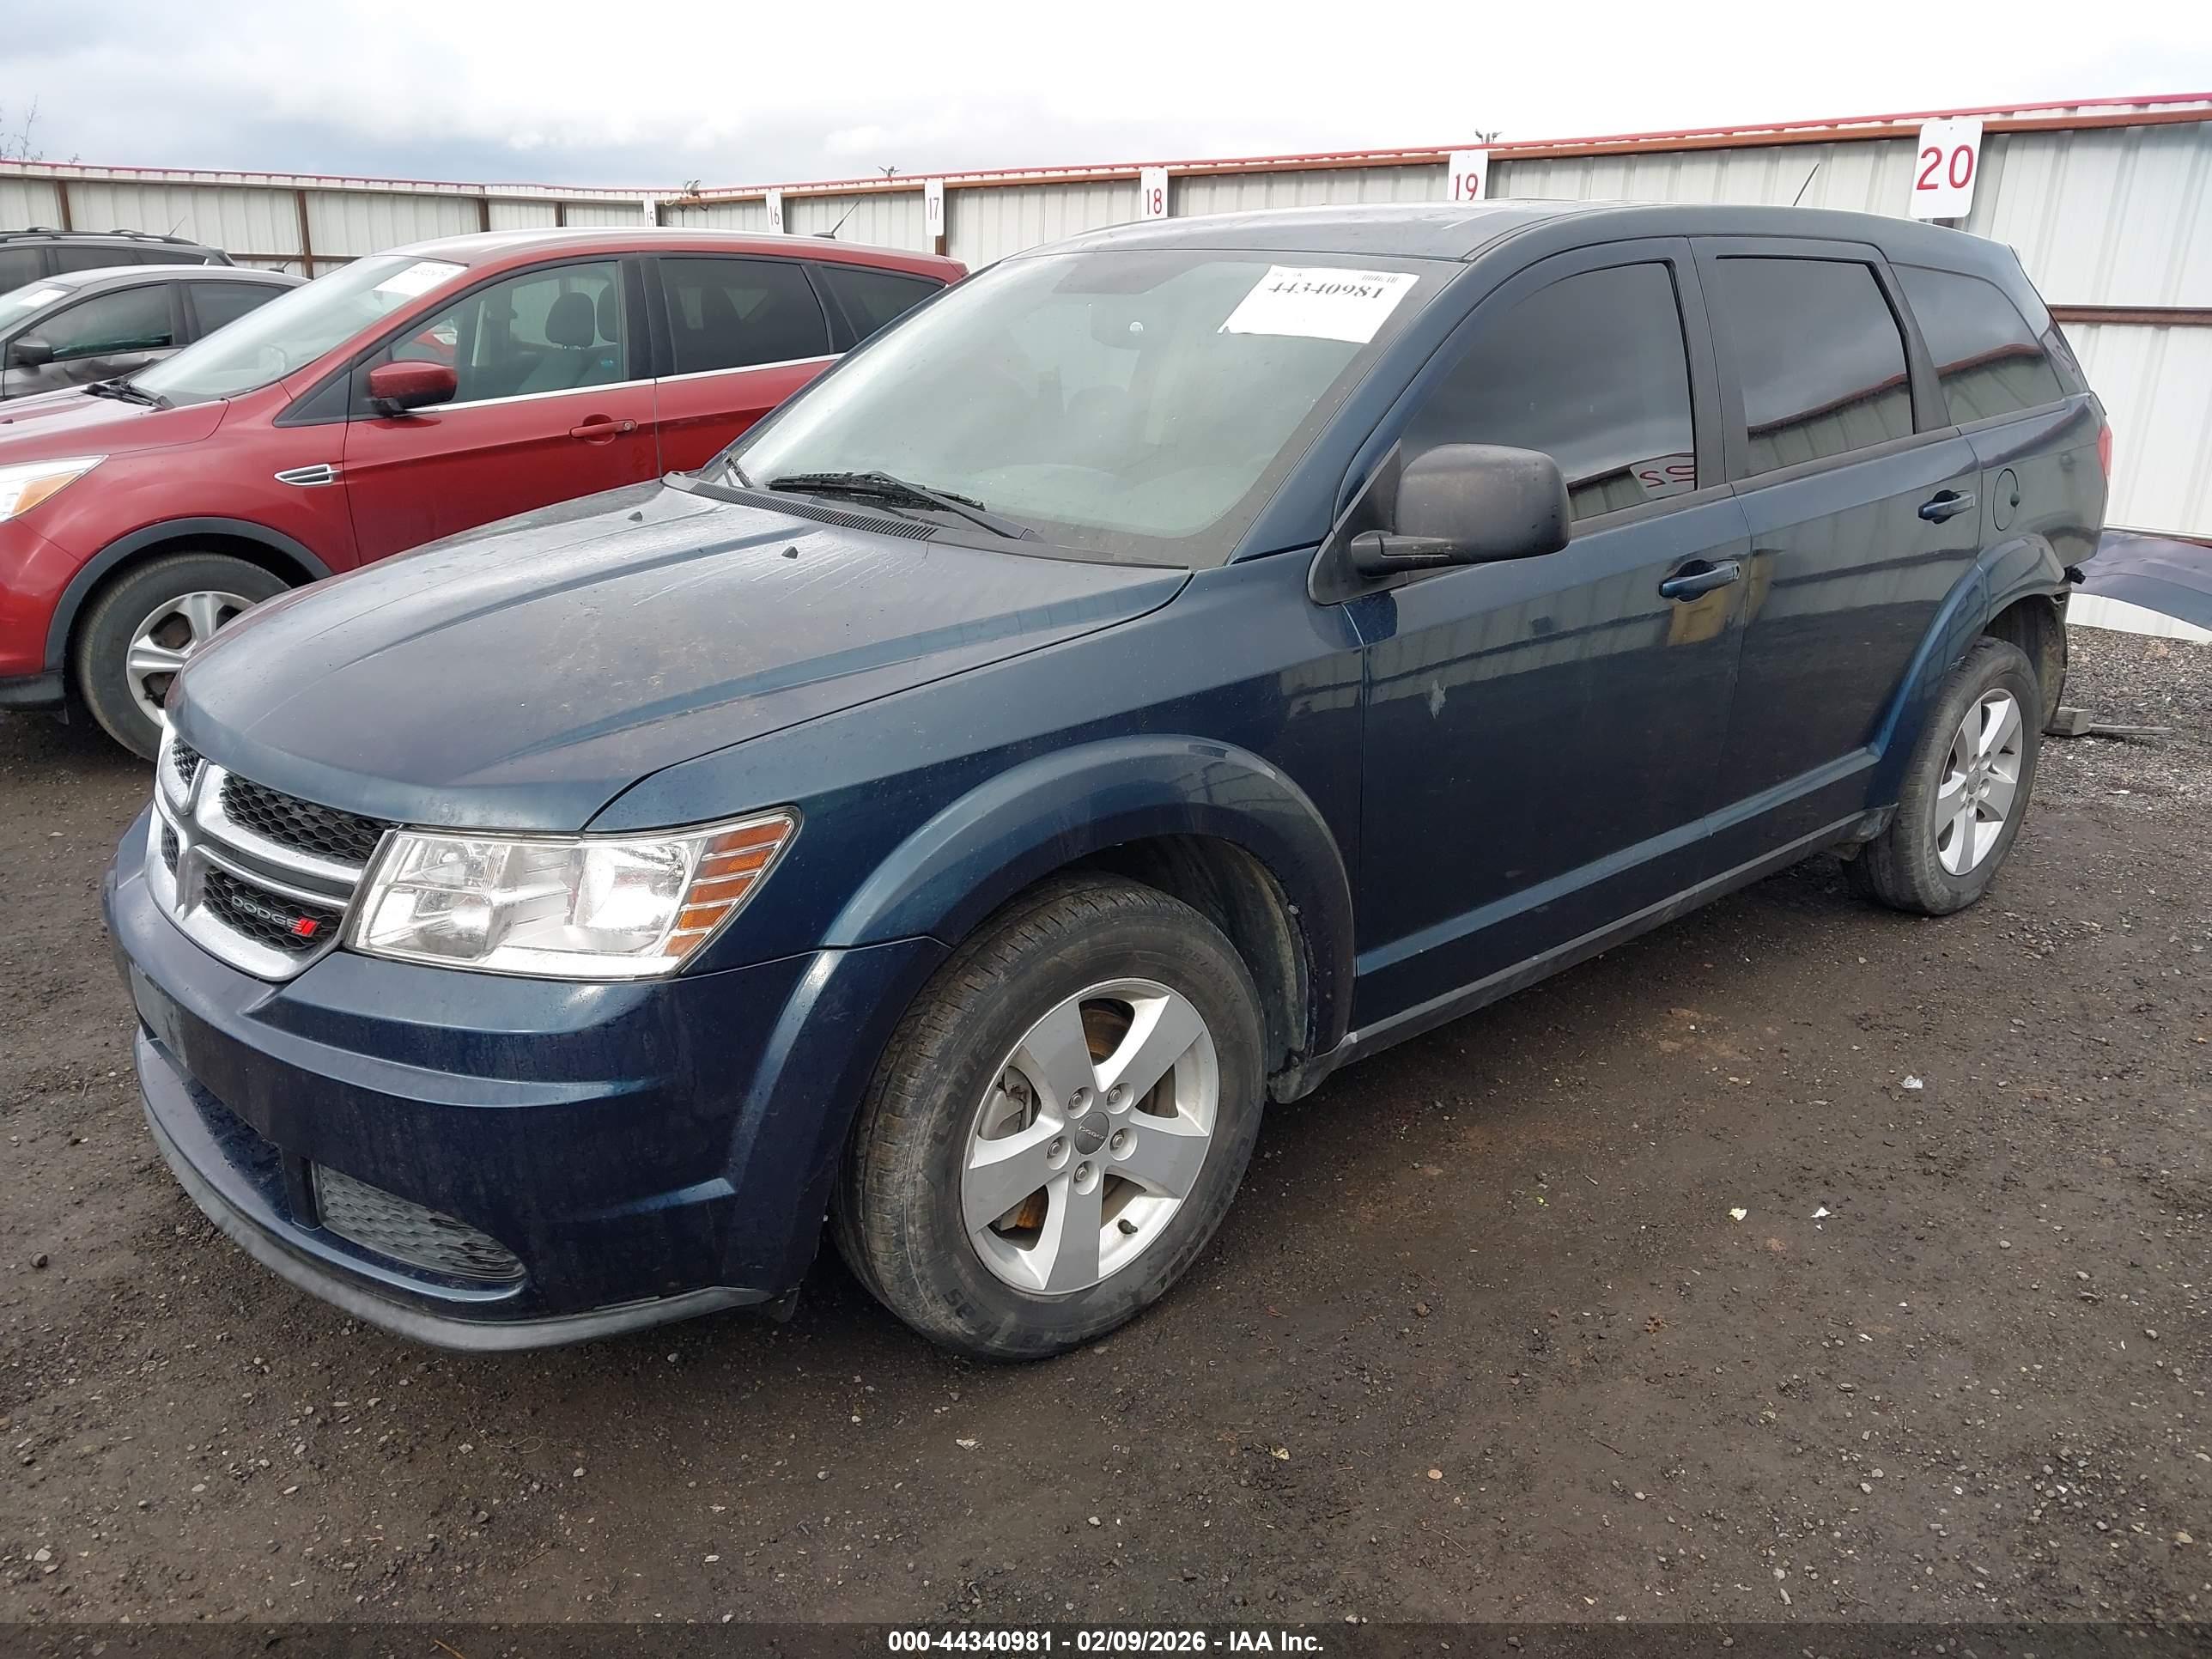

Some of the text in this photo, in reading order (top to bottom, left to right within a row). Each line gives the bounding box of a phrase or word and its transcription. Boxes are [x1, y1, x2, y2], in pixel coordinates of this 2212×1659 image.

[1916, 144, 1973, 191] 20
[1455, 173, 1479, 200] 19
[928, 197, 939, 221] 17
[1146, 188, 1162, 215] 18
[769, 205, 780, 226] 16
[1267, 281, 1385, 299] 44340981
[231, 896, 301, 929] DODGE
